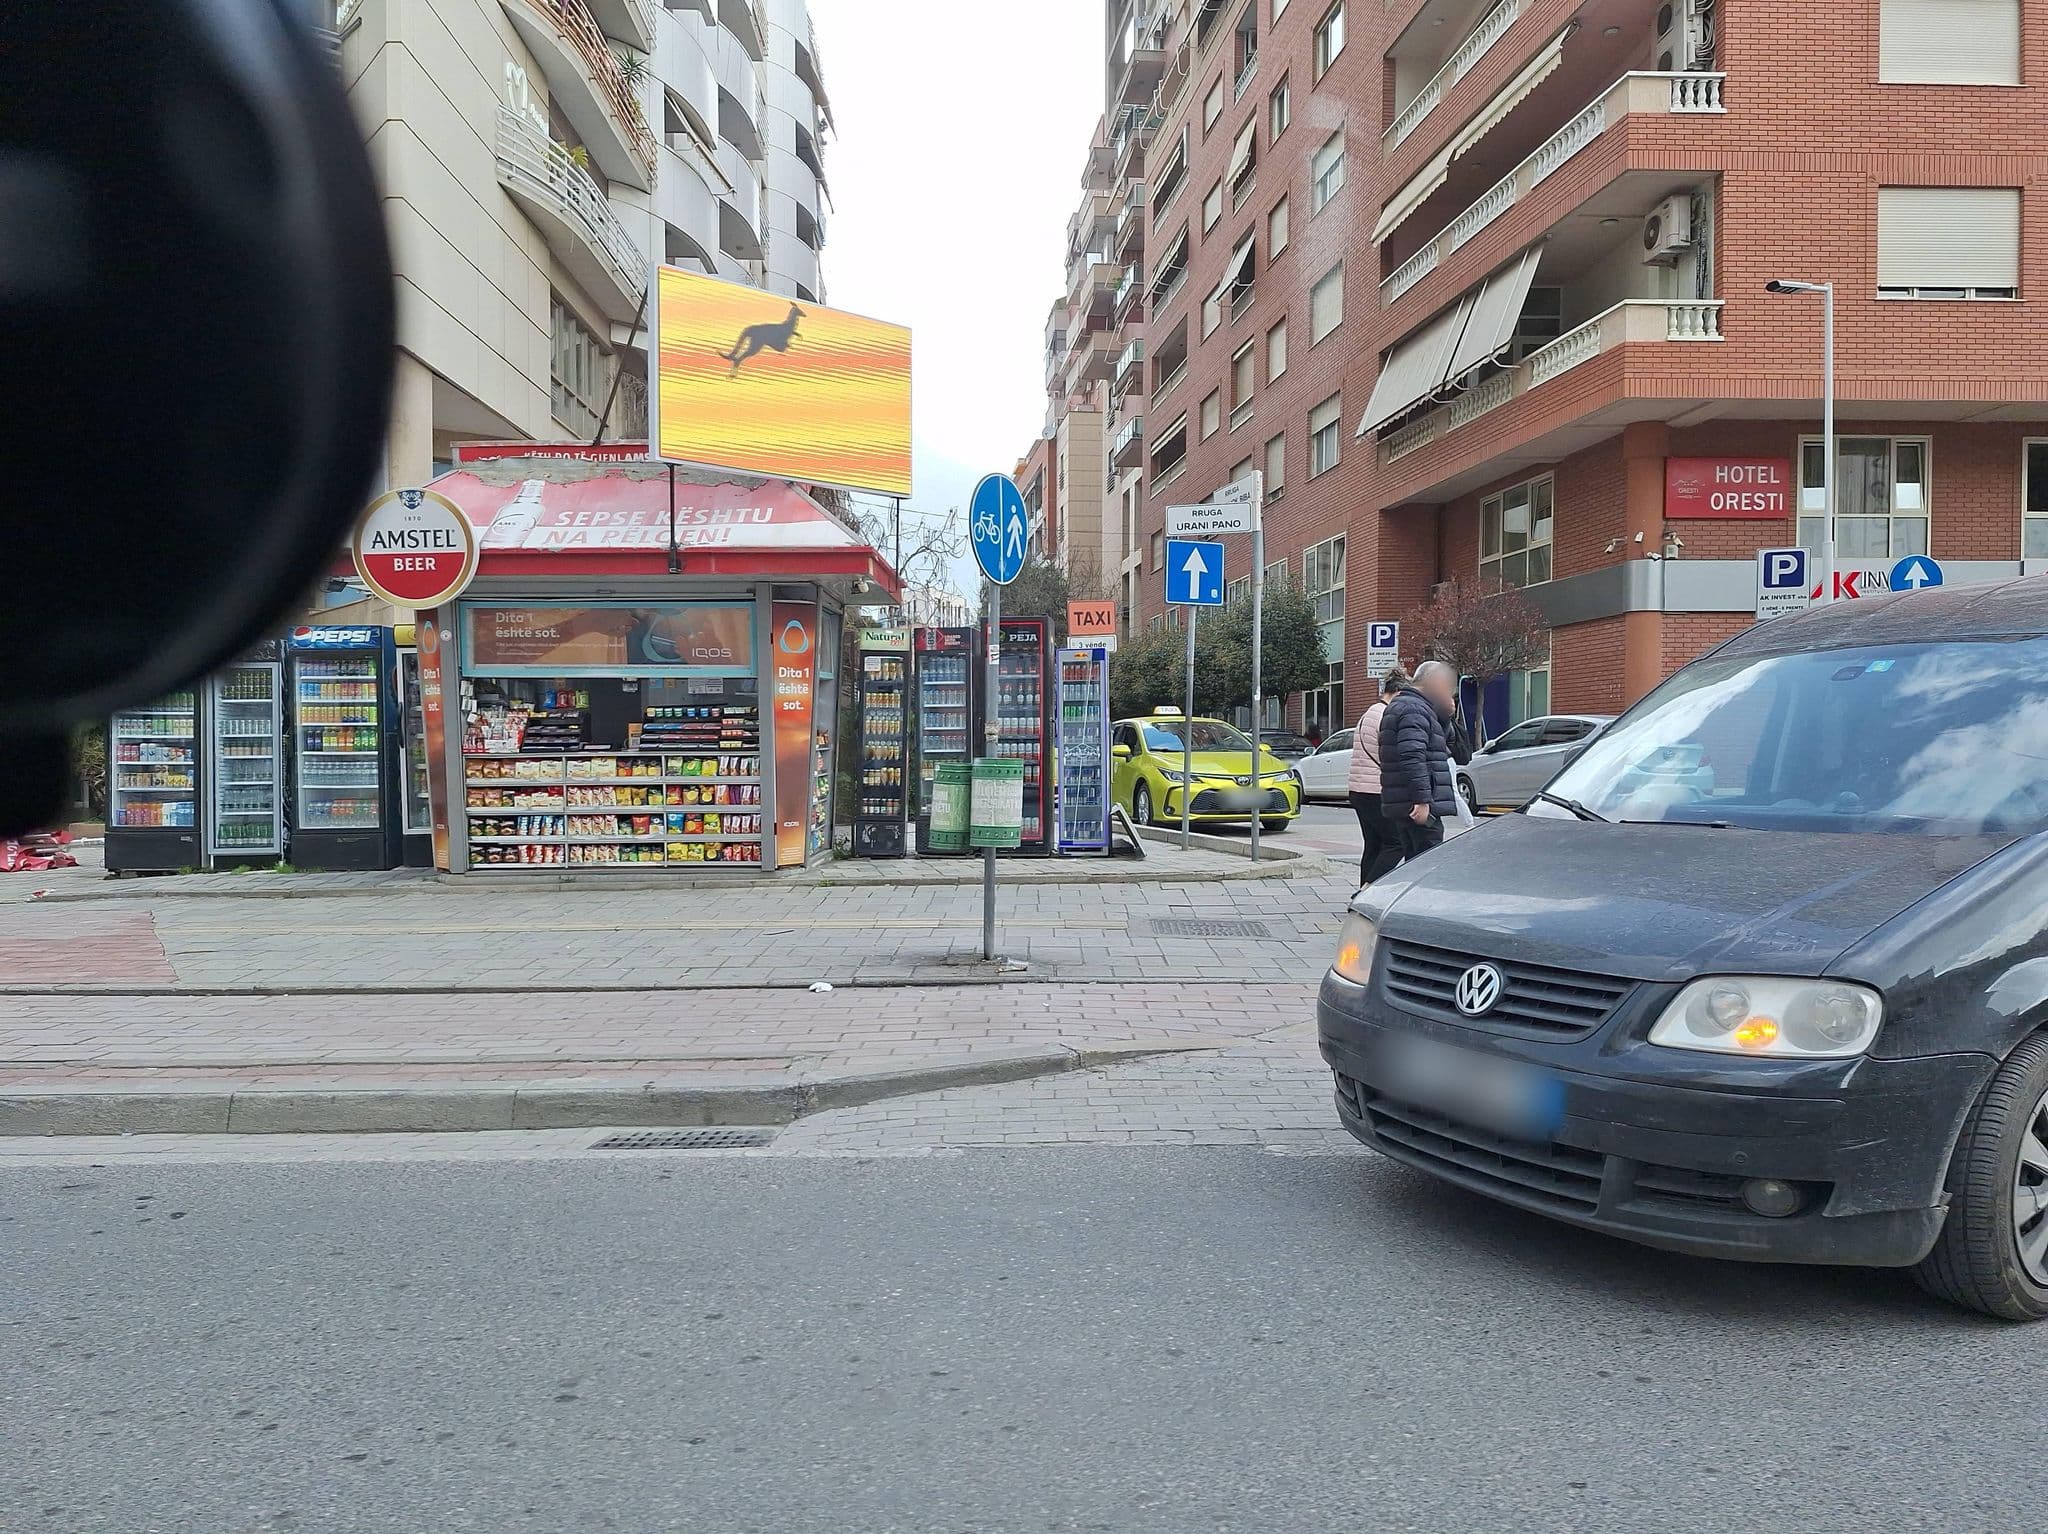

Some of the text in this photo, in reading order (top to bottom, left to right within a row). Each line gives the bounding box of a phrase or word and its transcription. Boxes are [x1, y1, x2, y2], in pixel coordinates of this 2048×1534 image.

[1715, 465, 1780, 484] HOTEL
[1710, 492, 1783, 511] ORESTI
[555, 507, 773, 527] SEPSE KËSHTU
[1192, 509, 1223, 517] RRUGA
[1176, 520, 1241, 531] URANI PANO
[372, 529, 457, 549] AMSTEL
[543, 529, 589, 544] NA
[394, 557, 437, 571] BEER
[1771, 554, 1798, 585] P
[495, 612, 525, 623] Dita
[1073, 611, 1111, 626] TAXI
[311, 630, 372, 643] PEPSI
[495, 627, 560, 638] është sot.
[865, 631, 905, 641] Natural
[1009, 633, 1038, 642] PEJA
[1375, 625, 1392, 646] P
[692, 647, 732, 659] IQOS
[778, 666, 810, 678] Dita 1
[778, 682, 809, 694] është
[783, 700, 804, 710] sot.
